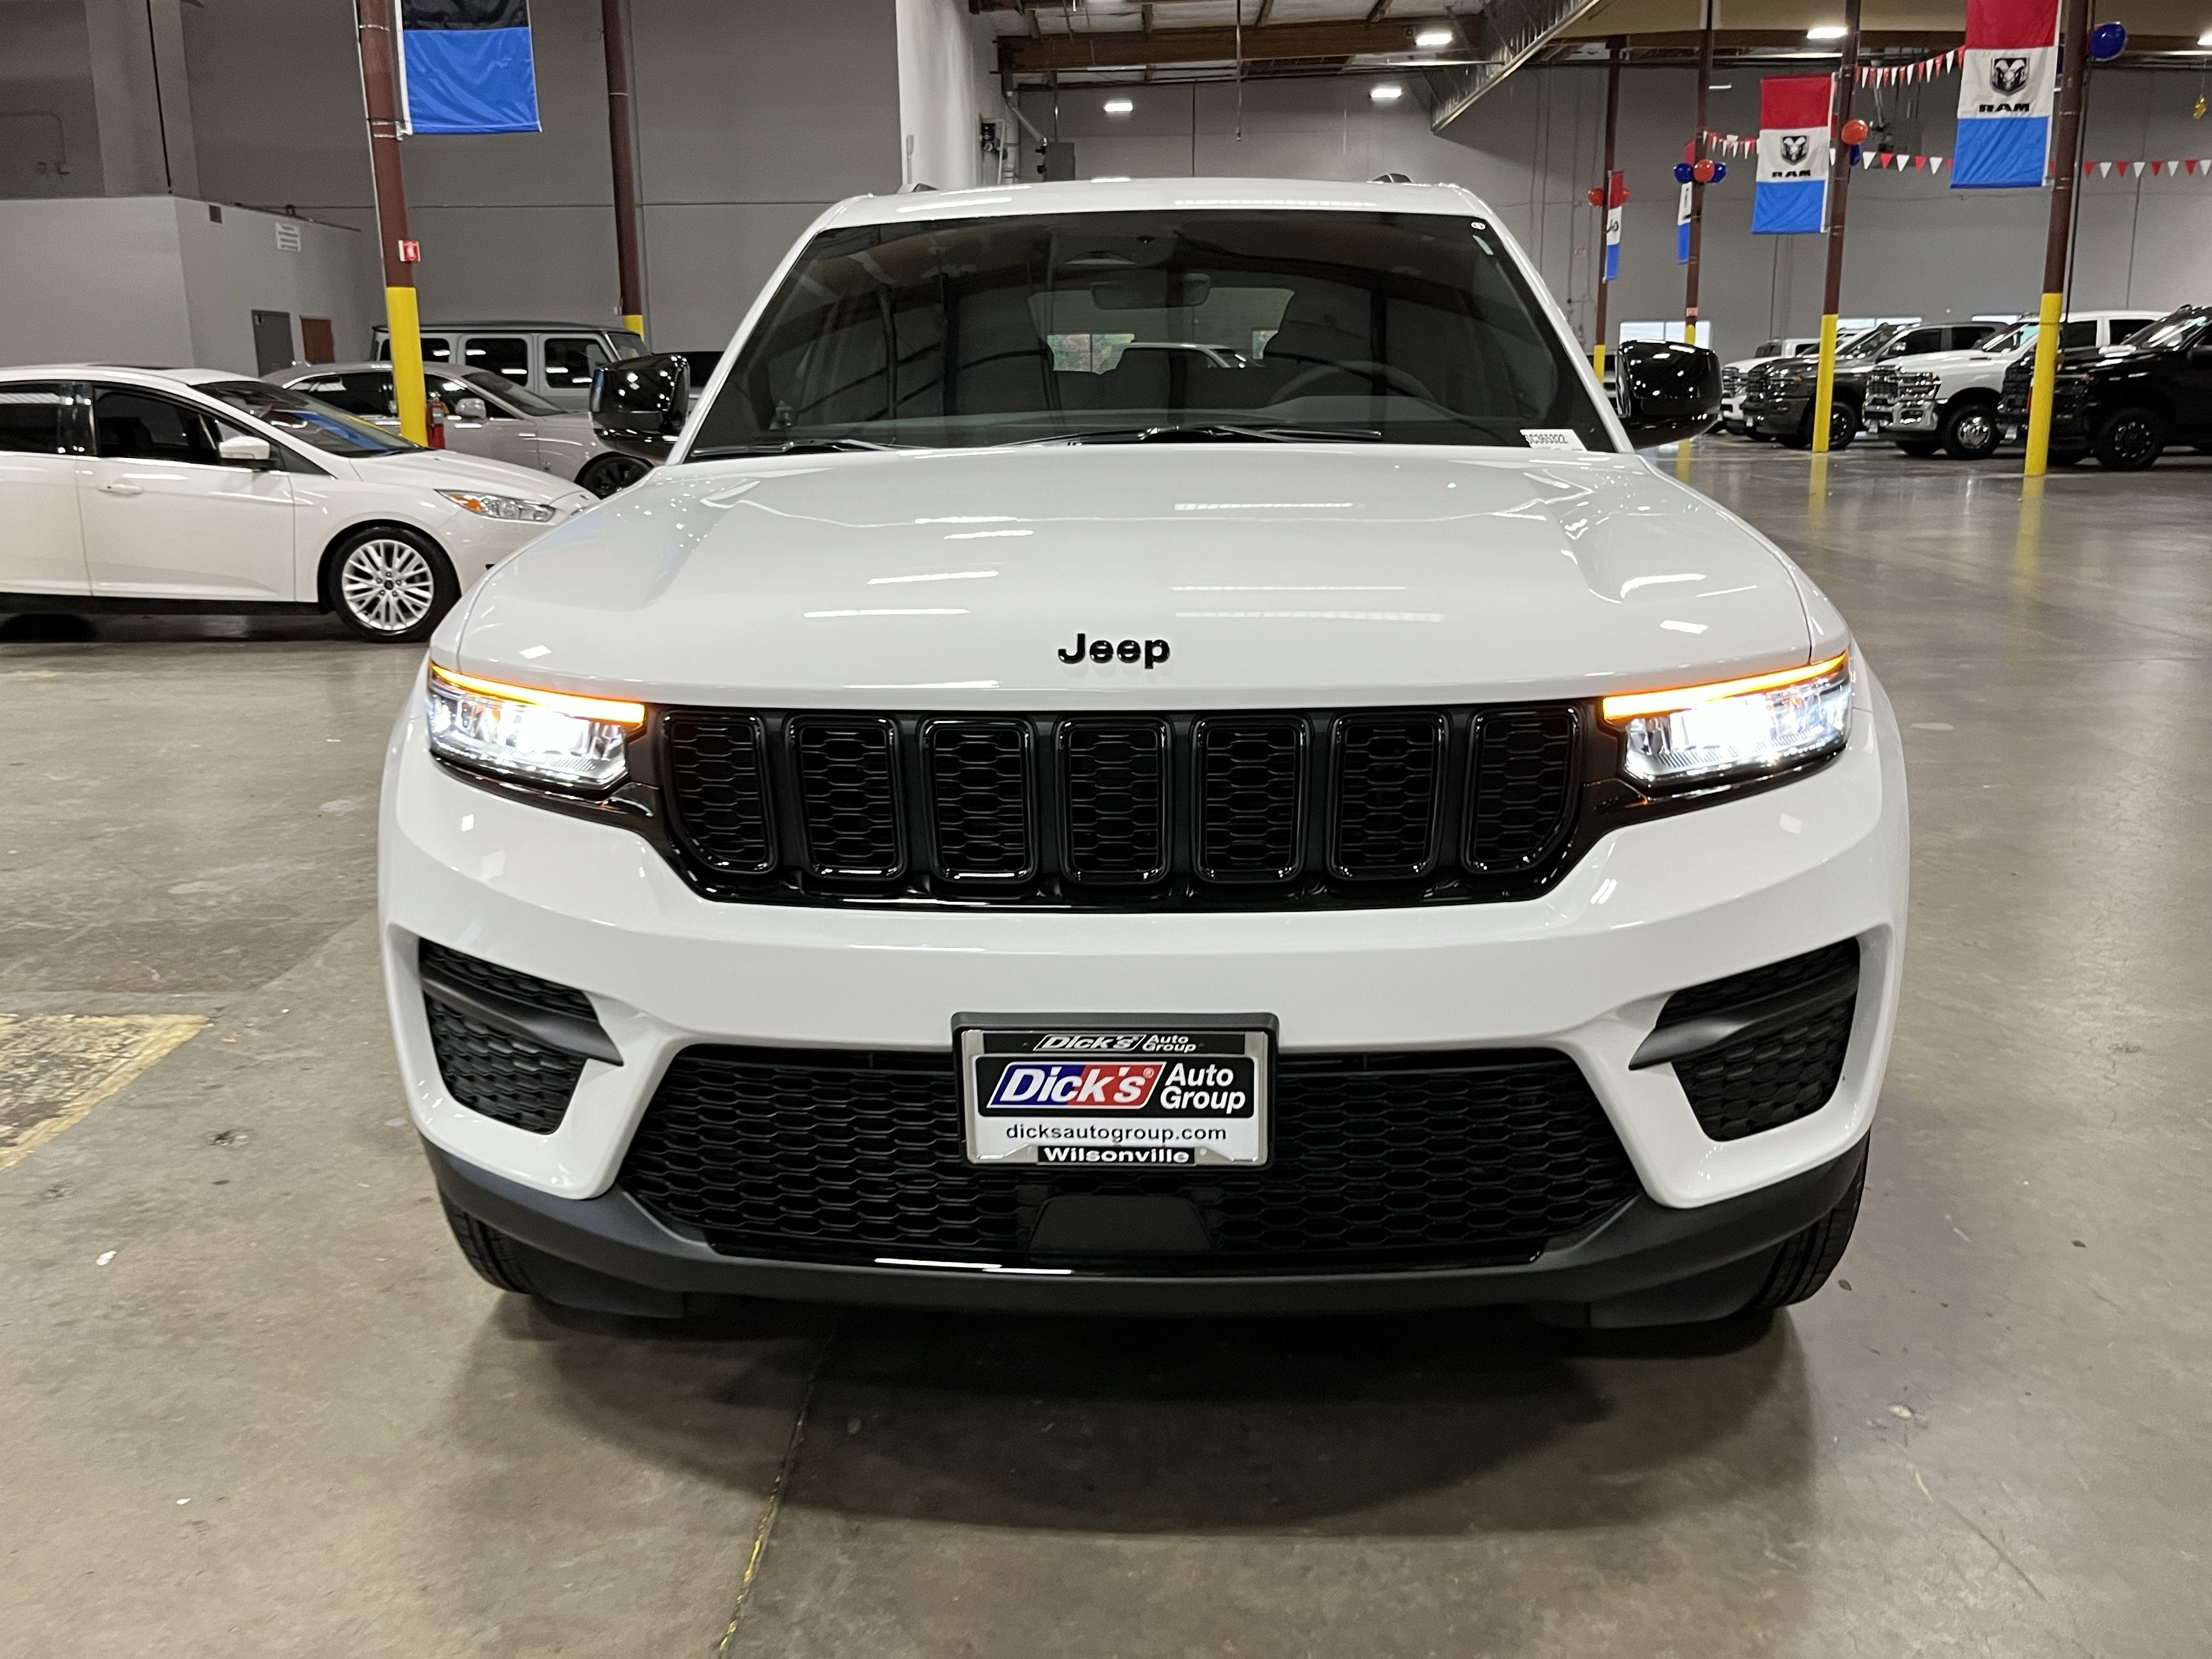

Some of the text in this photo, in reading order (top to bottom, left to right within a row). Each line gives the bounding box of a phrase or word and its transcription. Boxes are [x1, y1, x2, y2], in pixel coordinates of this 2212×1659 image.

[1978, 103, 2030, 112] RAM
[1771, 170, 1810, 178] RAM
[1058, 633, 1170, 669] Jeep
[1142, 1042, 1197, 1053] Group
[1147, 1035, 1189, 1043] Auto
[1165, 1062, 1234, 1087] Auto
[999, 1066, 1147, 1103] Dick's
[1160, 1086, 1246, 1115] Group
[1006, 1124, 1227, 1142] dicksautogroup.com
[1043, 1147, 1190, 1164] Wilsonville
